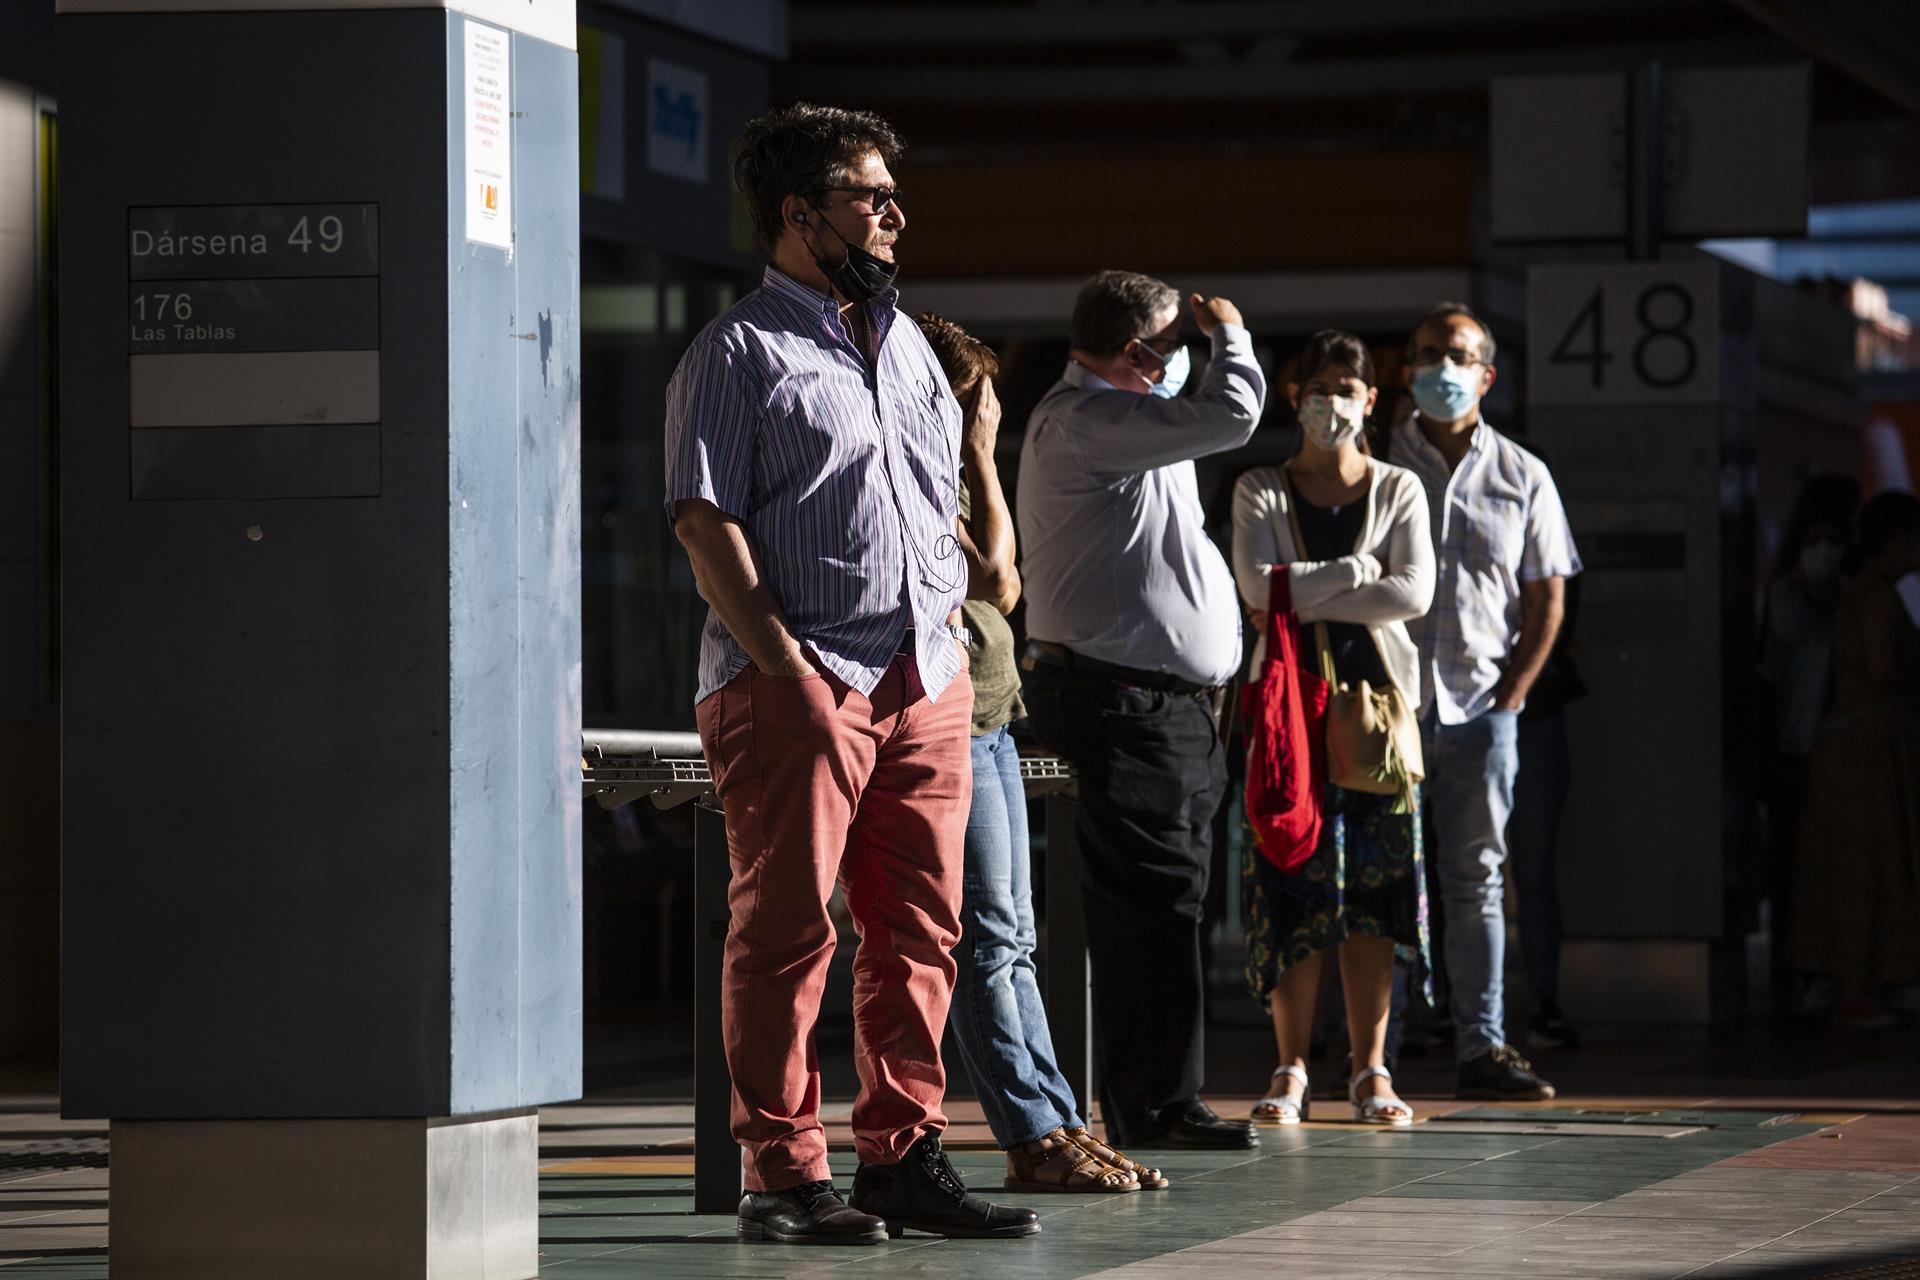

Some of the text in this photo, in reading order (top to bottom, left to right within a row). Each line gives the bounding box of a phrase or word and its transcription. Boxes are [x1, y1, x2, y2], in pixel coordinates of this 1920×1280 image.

[131, 215, 344, 257] Dársena 49
[133, 293, 193, 321] 176
[131, 324, 236, 341] Las Tablas
[1550, 284, 1697, 388] 48
